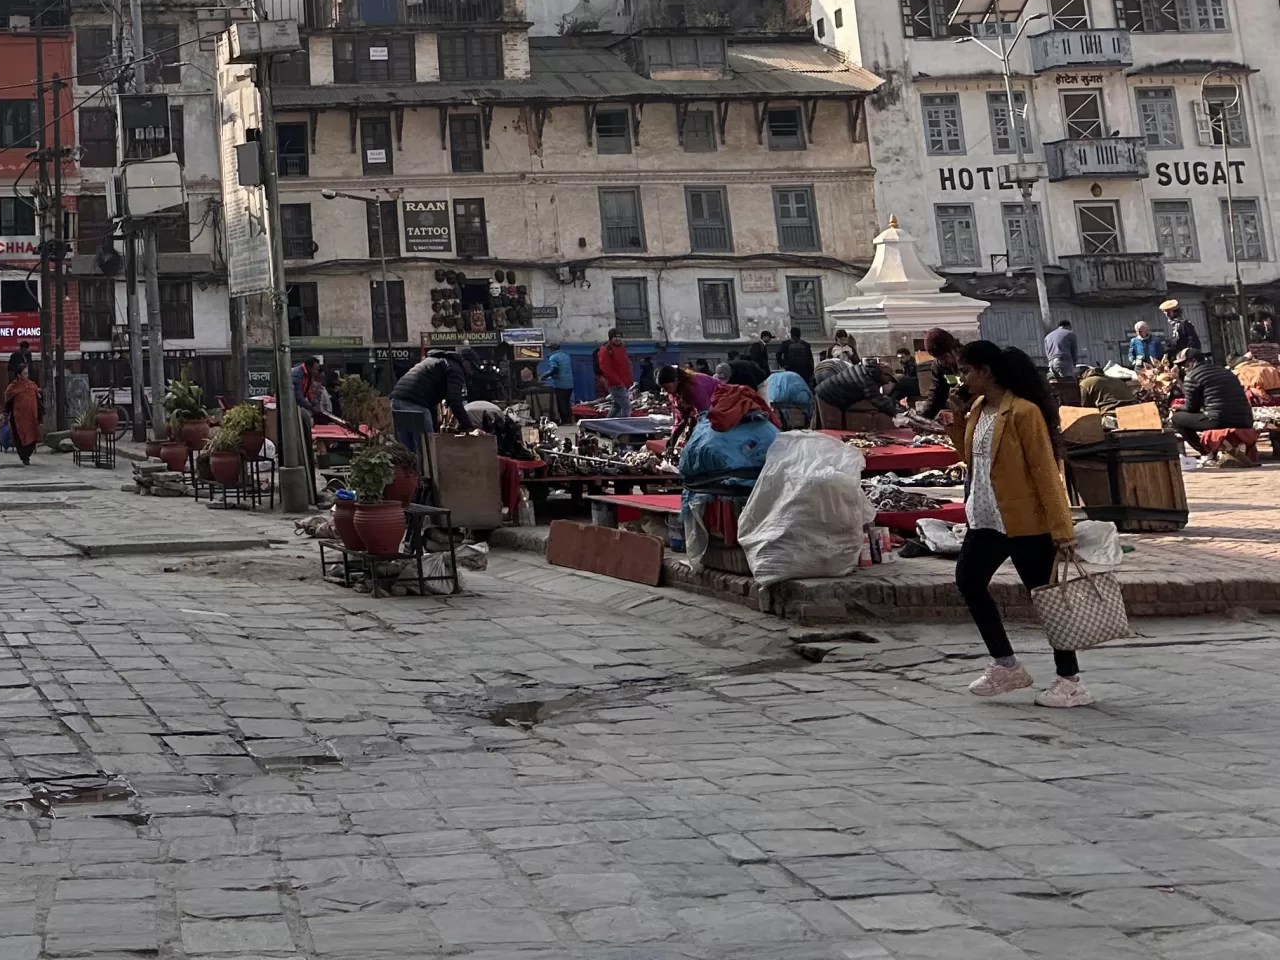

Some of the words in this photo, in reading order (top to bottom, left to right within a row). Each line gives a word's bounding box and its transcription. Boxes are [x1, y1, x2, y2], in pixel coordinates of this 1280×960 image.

[1155, 160, 1246, 186] SUGAT
[939, 166, 1014, 190] HOT
[405, 202, 446, 211] RAAN
[407, 227, 449, 235] TATTOO
[431, 333, 457, 341] KUMARI
[457, 332, 497, 340] HANDICRAFT
[376, 349, 409, 358] TATOO
